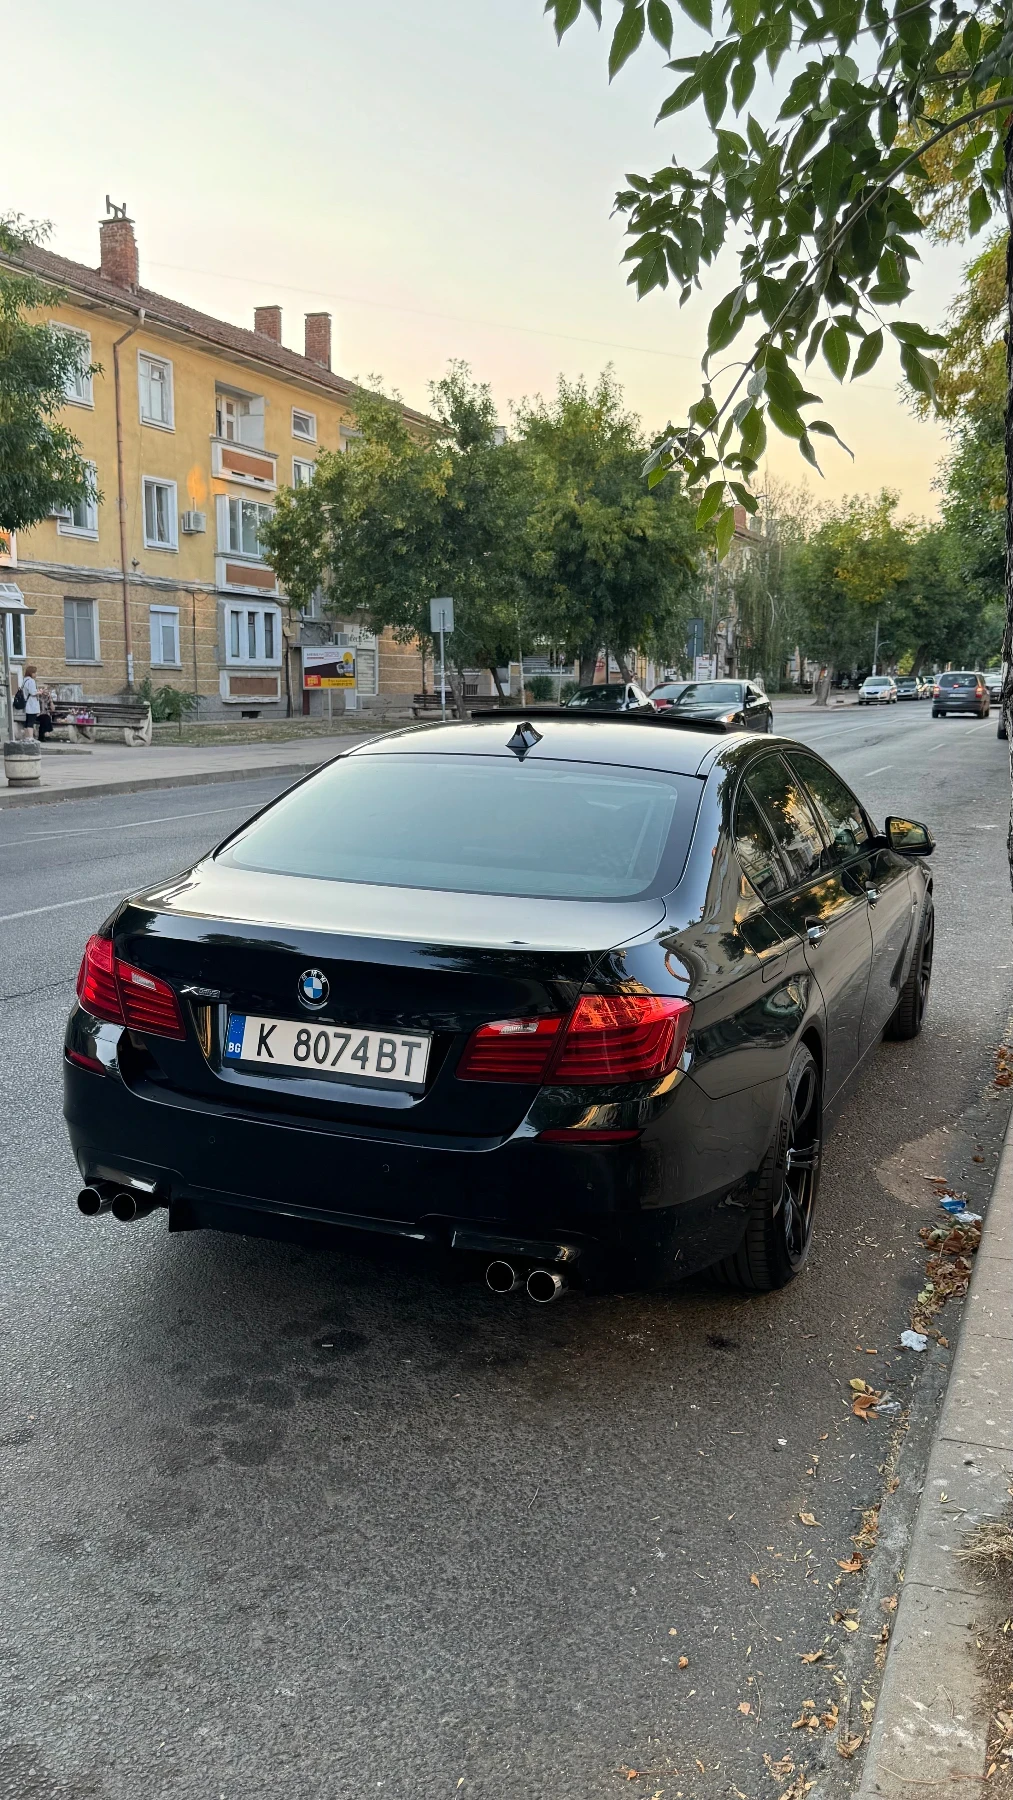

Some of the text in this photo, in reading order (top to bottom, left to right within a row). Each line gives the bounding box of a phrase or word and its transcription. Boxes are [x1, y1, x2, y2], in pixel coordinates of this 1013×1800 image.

[301, 970, 327, 984] BMW
[227, 1042, 241, 1054] BG
[256, 1023, 422, 1077] K 8074BT
